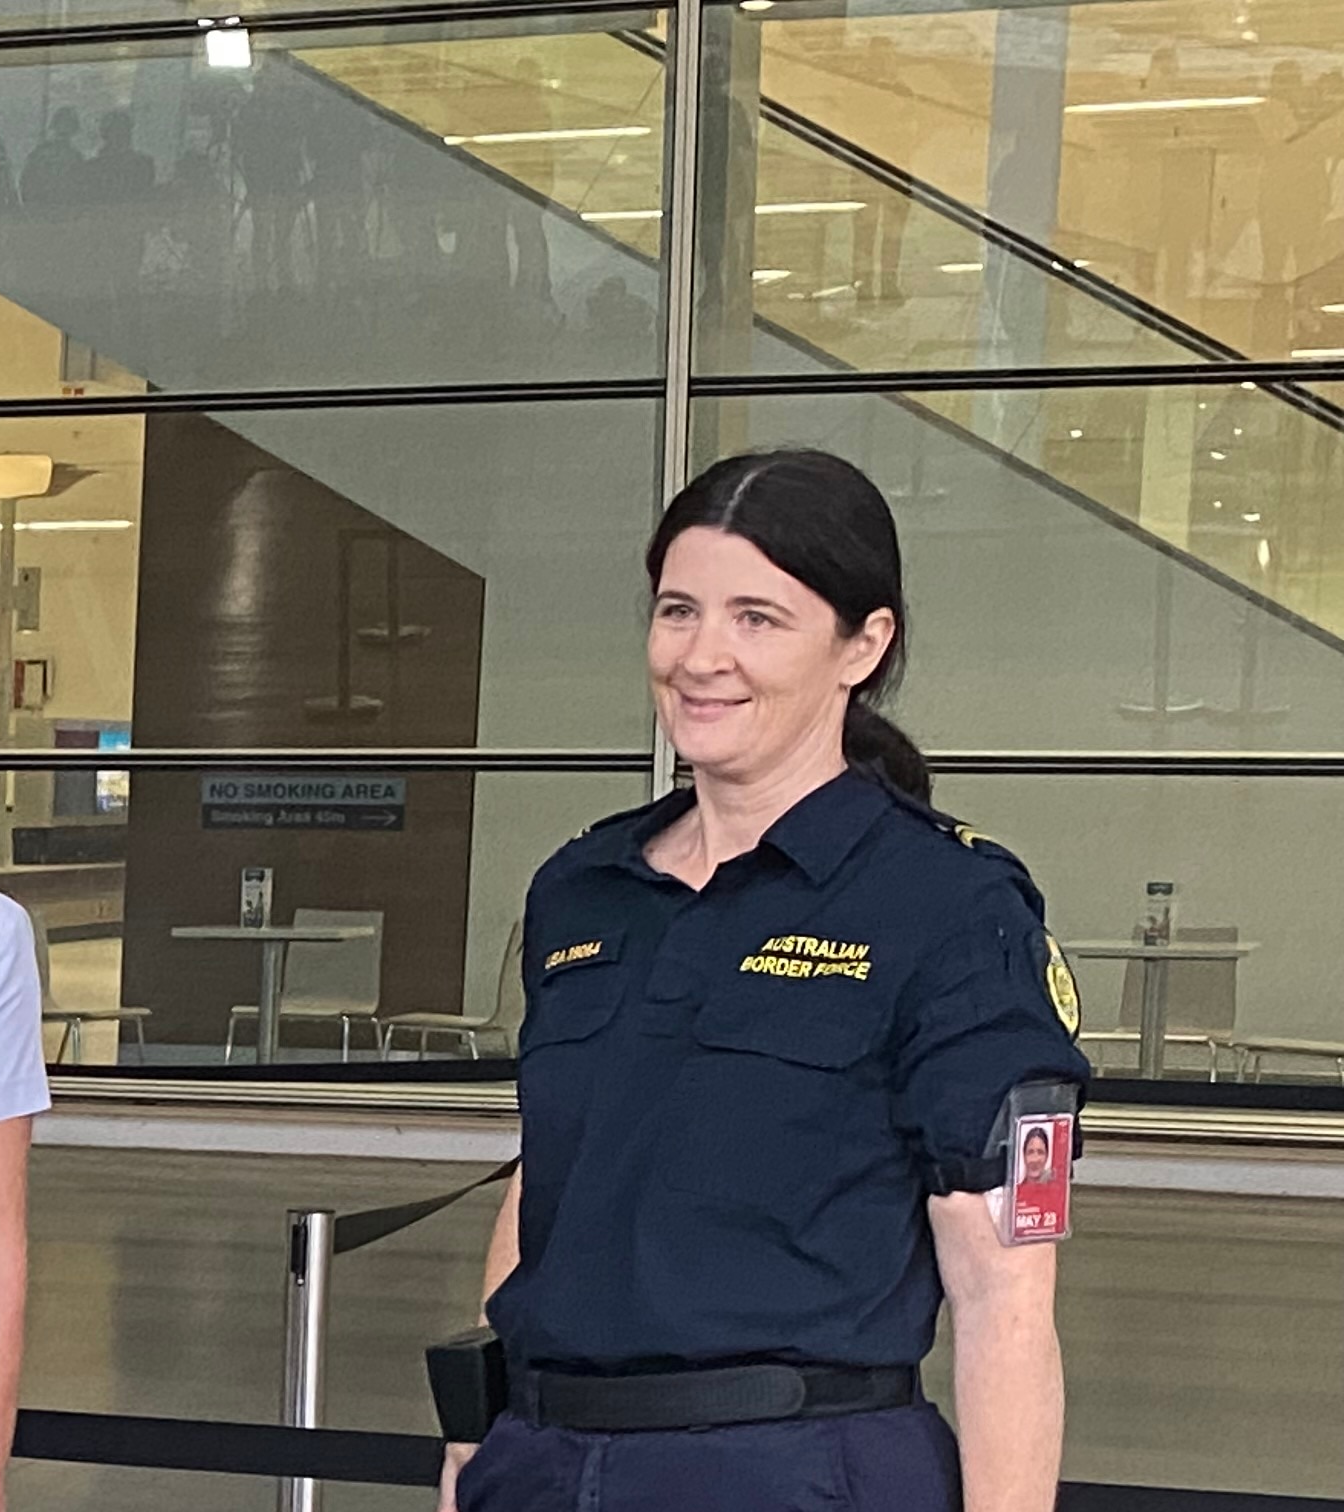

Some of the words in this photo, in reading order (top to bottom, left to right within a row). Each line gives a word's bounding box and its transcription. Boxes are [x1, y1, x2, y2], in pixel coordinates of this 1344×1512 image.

[209, 783, 238, 799] NO
[244, 783, 336, 799] SMOKING
[341, 783, 396, 799] AREA
[211, 810, 274, 826] Smoking
[761, 935, 870, 960] AUSTRALIAN
[740, 956, 812, 978] BORDER
[812, 961, 872, 981] FORCE
